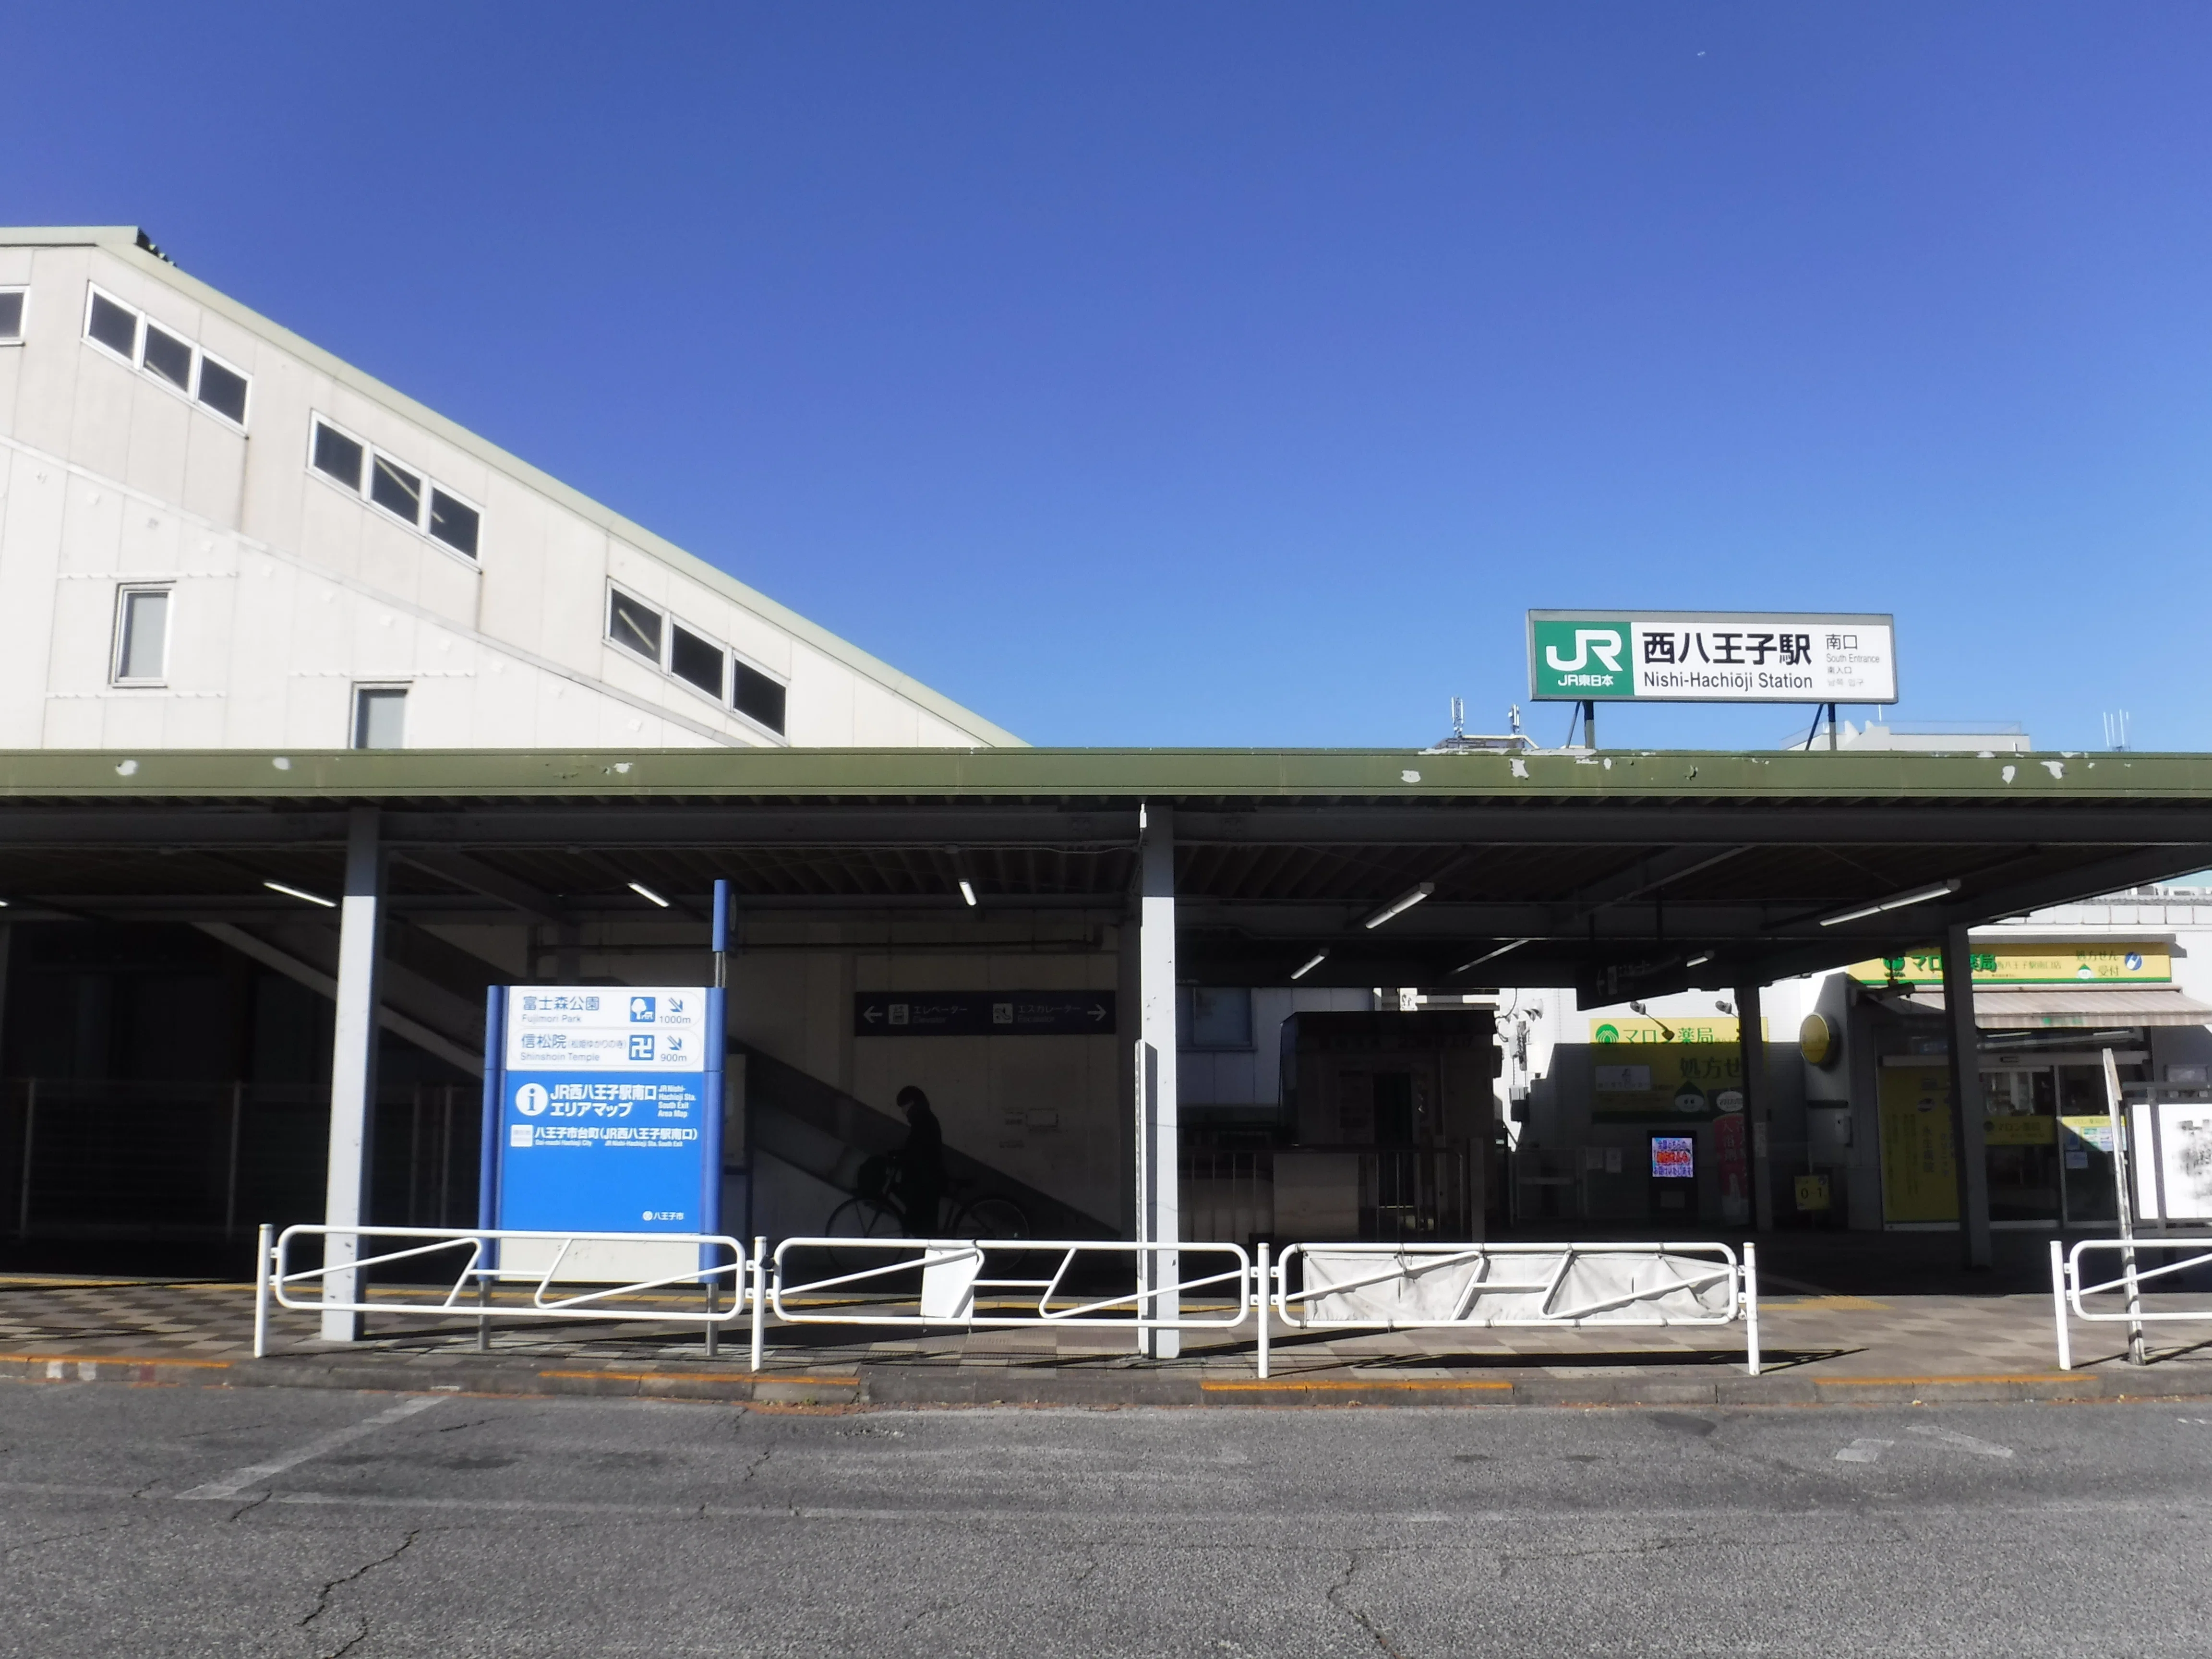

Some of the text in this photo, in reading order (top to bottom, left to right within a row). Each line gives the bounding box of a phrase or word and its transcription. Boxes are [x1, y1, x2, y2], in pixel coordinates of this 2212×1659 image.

[1642, 631, 1812, 666] 西八王子駅
[1825, 634, 1858, 649] 南口
[1546, 629, 1623, 672] JR
[1826, 653, 1880, 663] South Entrance
[1557, 673, 1614, 687] JR東日本
[1644, 671, 1813, 692] Nishi-Hachiōji Station
[1910, 954, 1997, 973] マロ薬局
[2098, 965, 2119, 976] 受付
[523, 996, 600, 1011] 富士森公園
[914, 1006, 967, 1014] エレベーター
[1017, 1004, 1081, 1014] エスカレーター
[522, 1014, 582, 1024] Fujimori Park
[659, 1015, 691, 1024] 1000m
[521, 1034, 566, 1048] 信松院
[1623, 1027, 1714, 1044] マロ薬局
[520, 1052, 600, 1062] Shinshoin Temple
[661, 1053, 687, 1062] 900m
[550, 1084, 657, 1101] JR西八王子駅南口
[550, 1102, 633, 1117] エリアマップ
[534, 1127, 698, 1141] 八王子市台町(JR西八王子駅南口)
[653, 1212, 685, 1220] 八王子市
